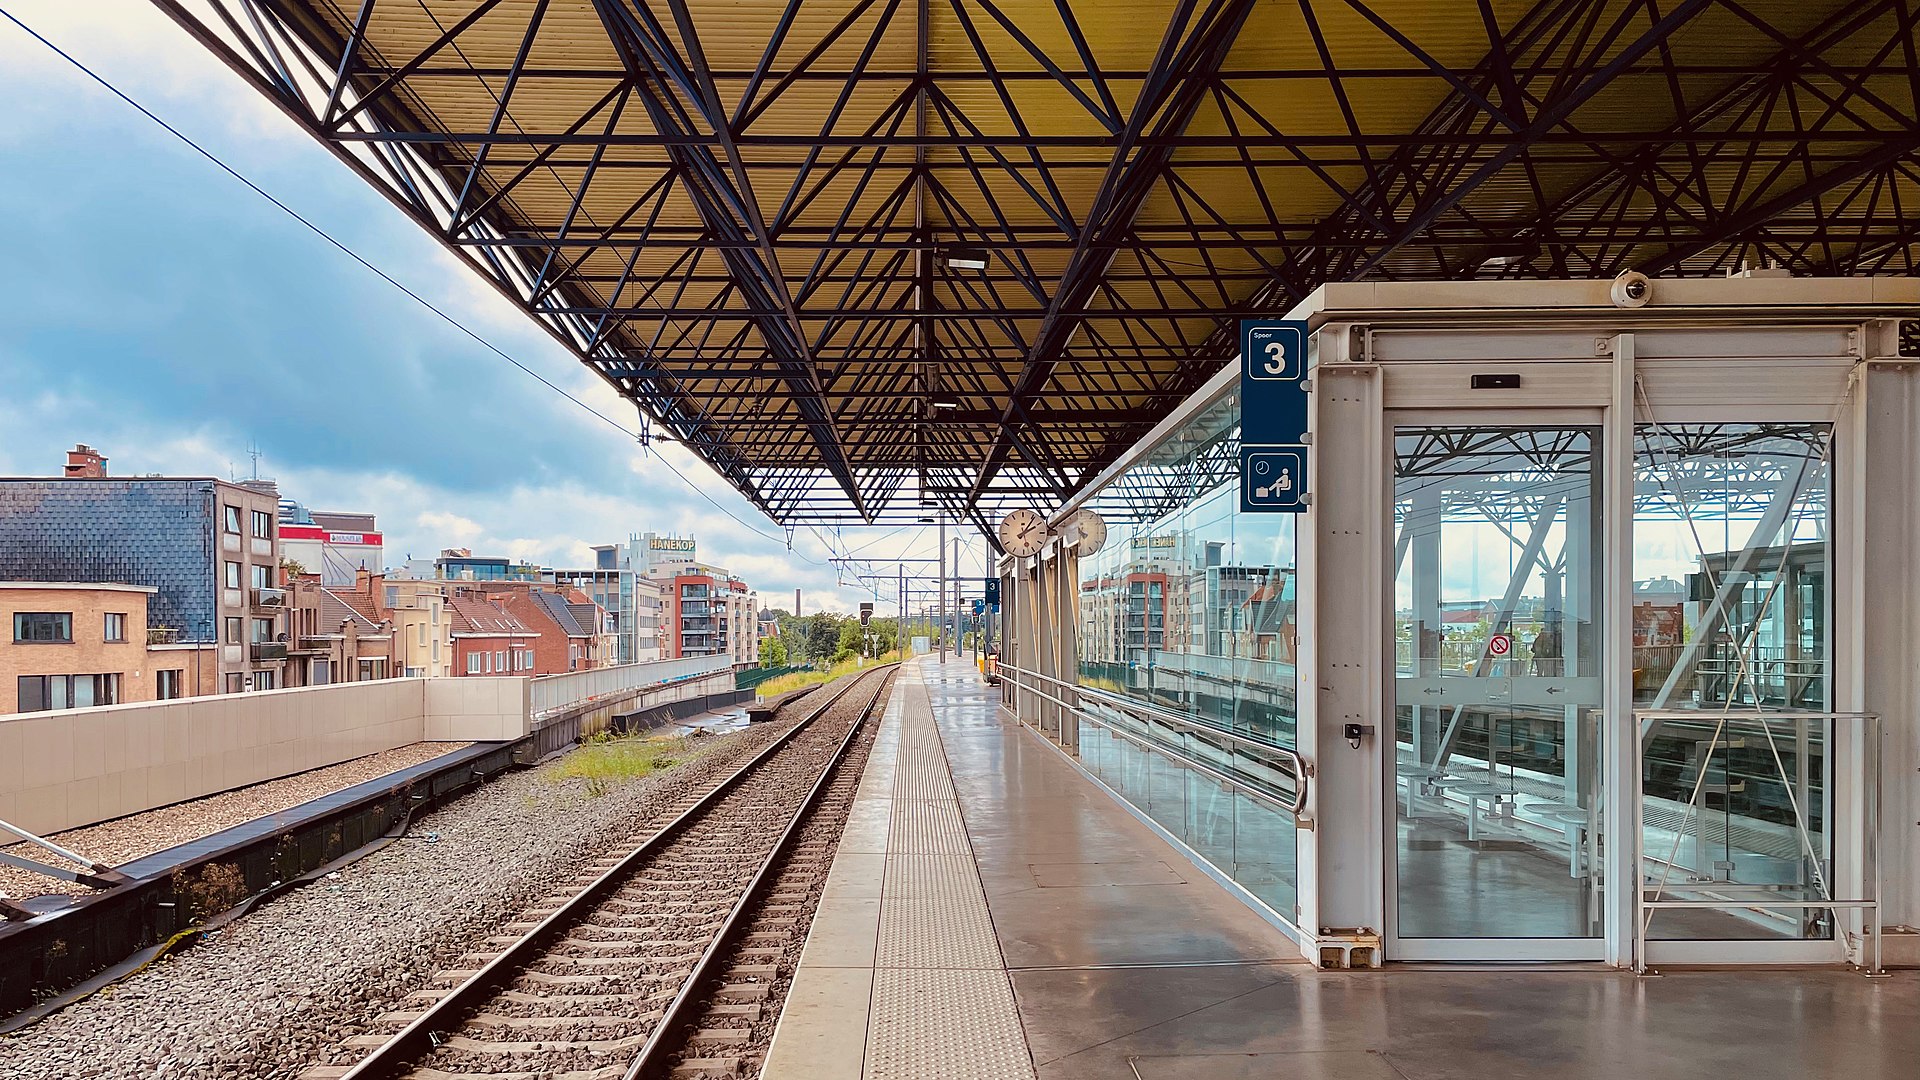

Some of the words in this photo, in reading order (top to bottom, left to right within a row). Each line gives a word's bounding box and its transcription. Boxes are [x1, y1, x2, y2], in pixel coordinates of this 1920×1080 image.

[1264, 342, 1286, 374] 3
[650, 540, 695, 550] HANEKOP
[989, 583, 996, 591] 3
